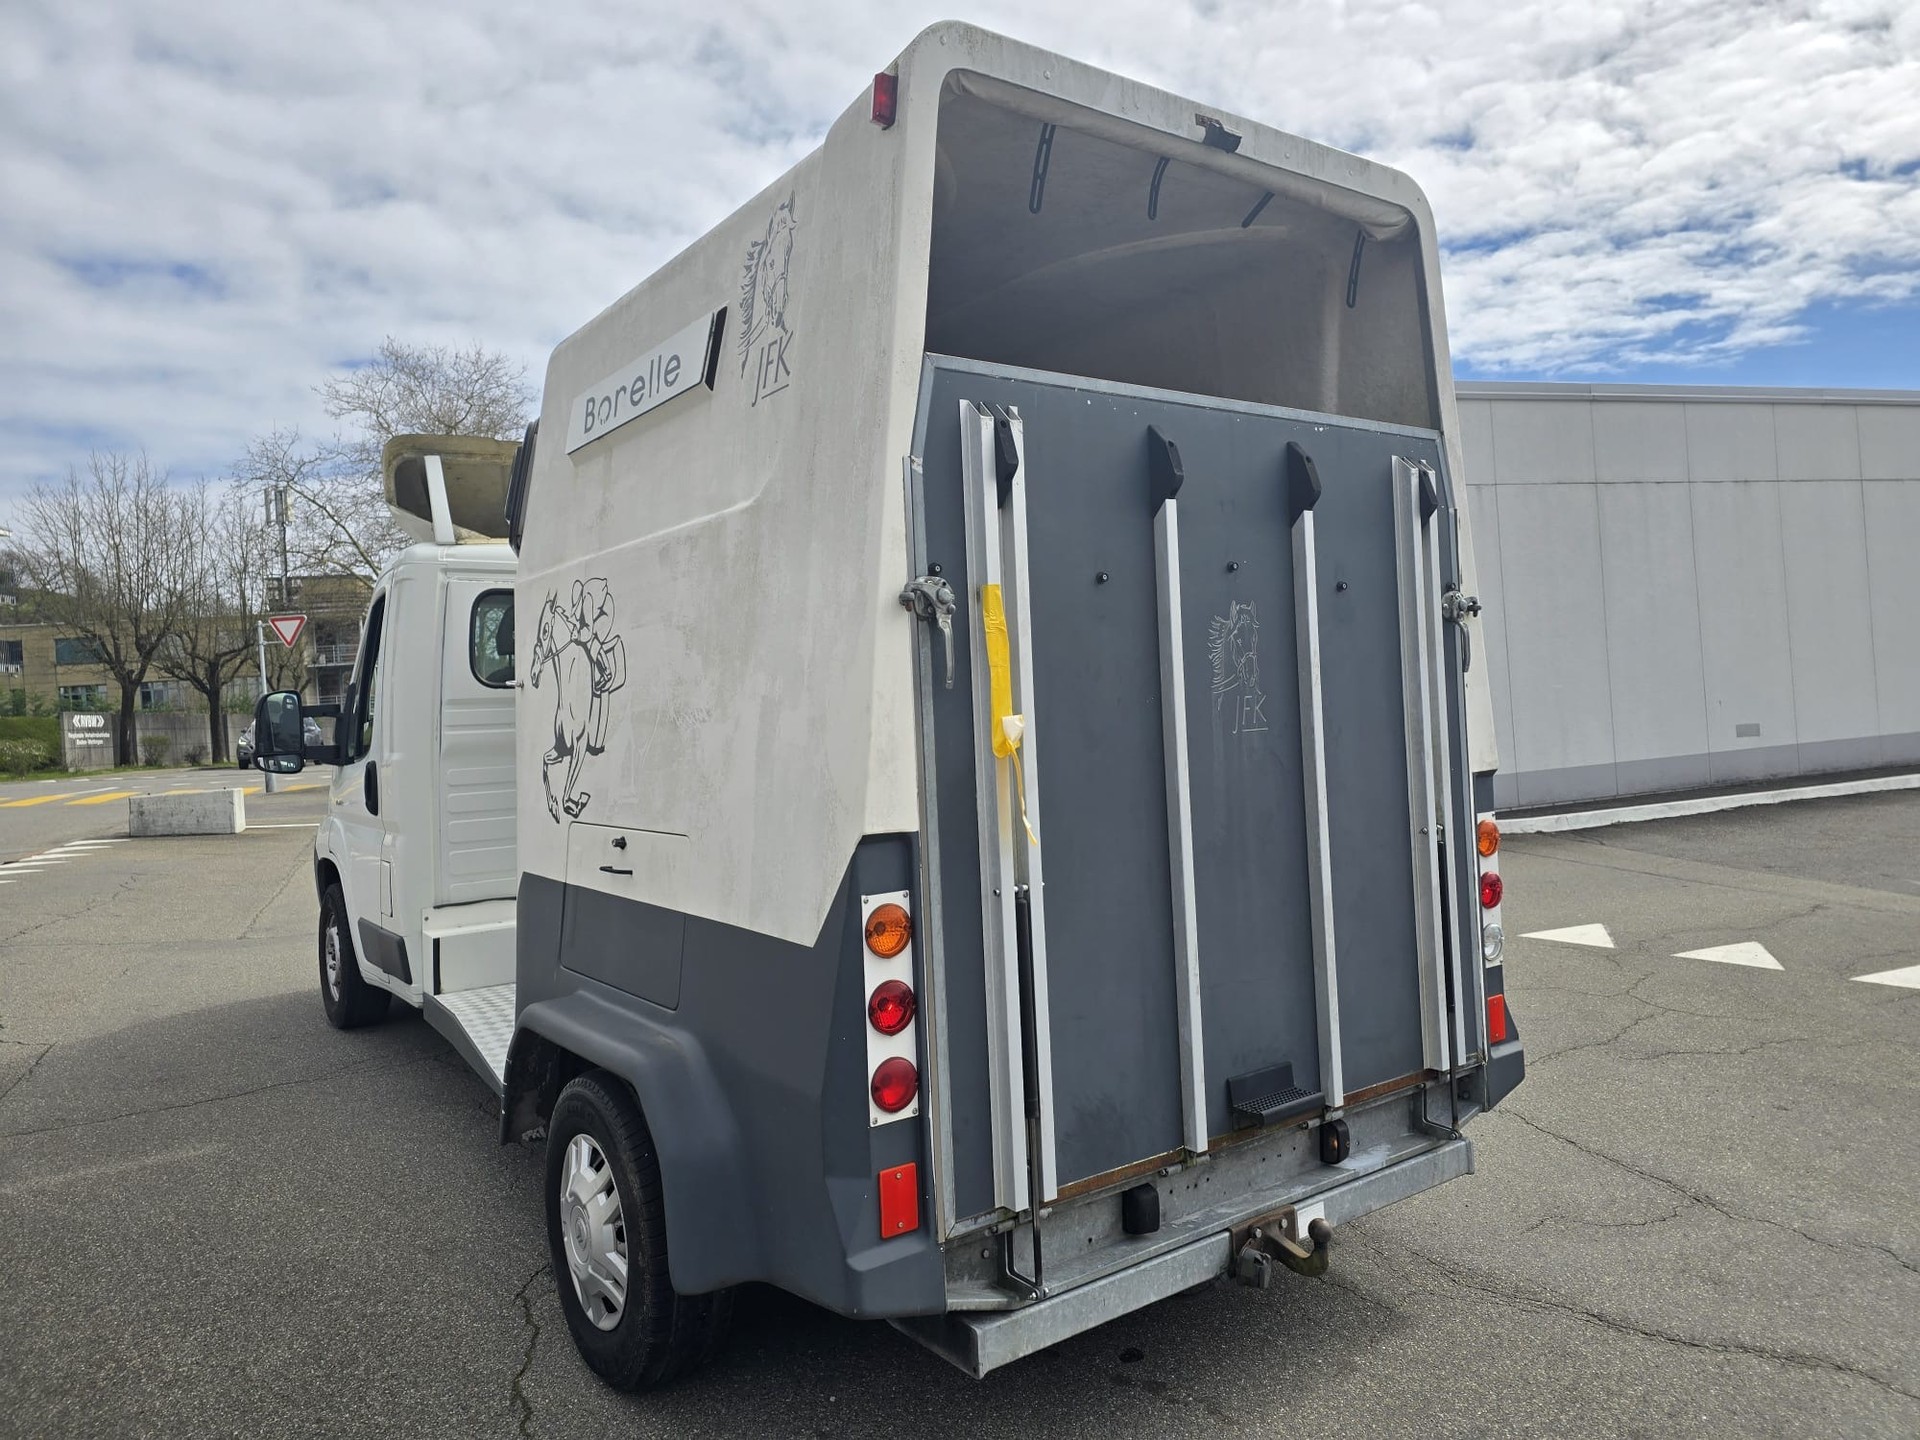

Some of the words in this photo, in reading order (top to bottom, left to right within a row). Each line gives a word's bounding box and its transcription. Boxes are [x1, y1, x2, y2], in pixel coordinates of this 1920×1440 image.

[583, 353, 681, 435] Borelle
[751, 330, 793, 407] JFK
[1232, 694, 1267, 734] JFK
